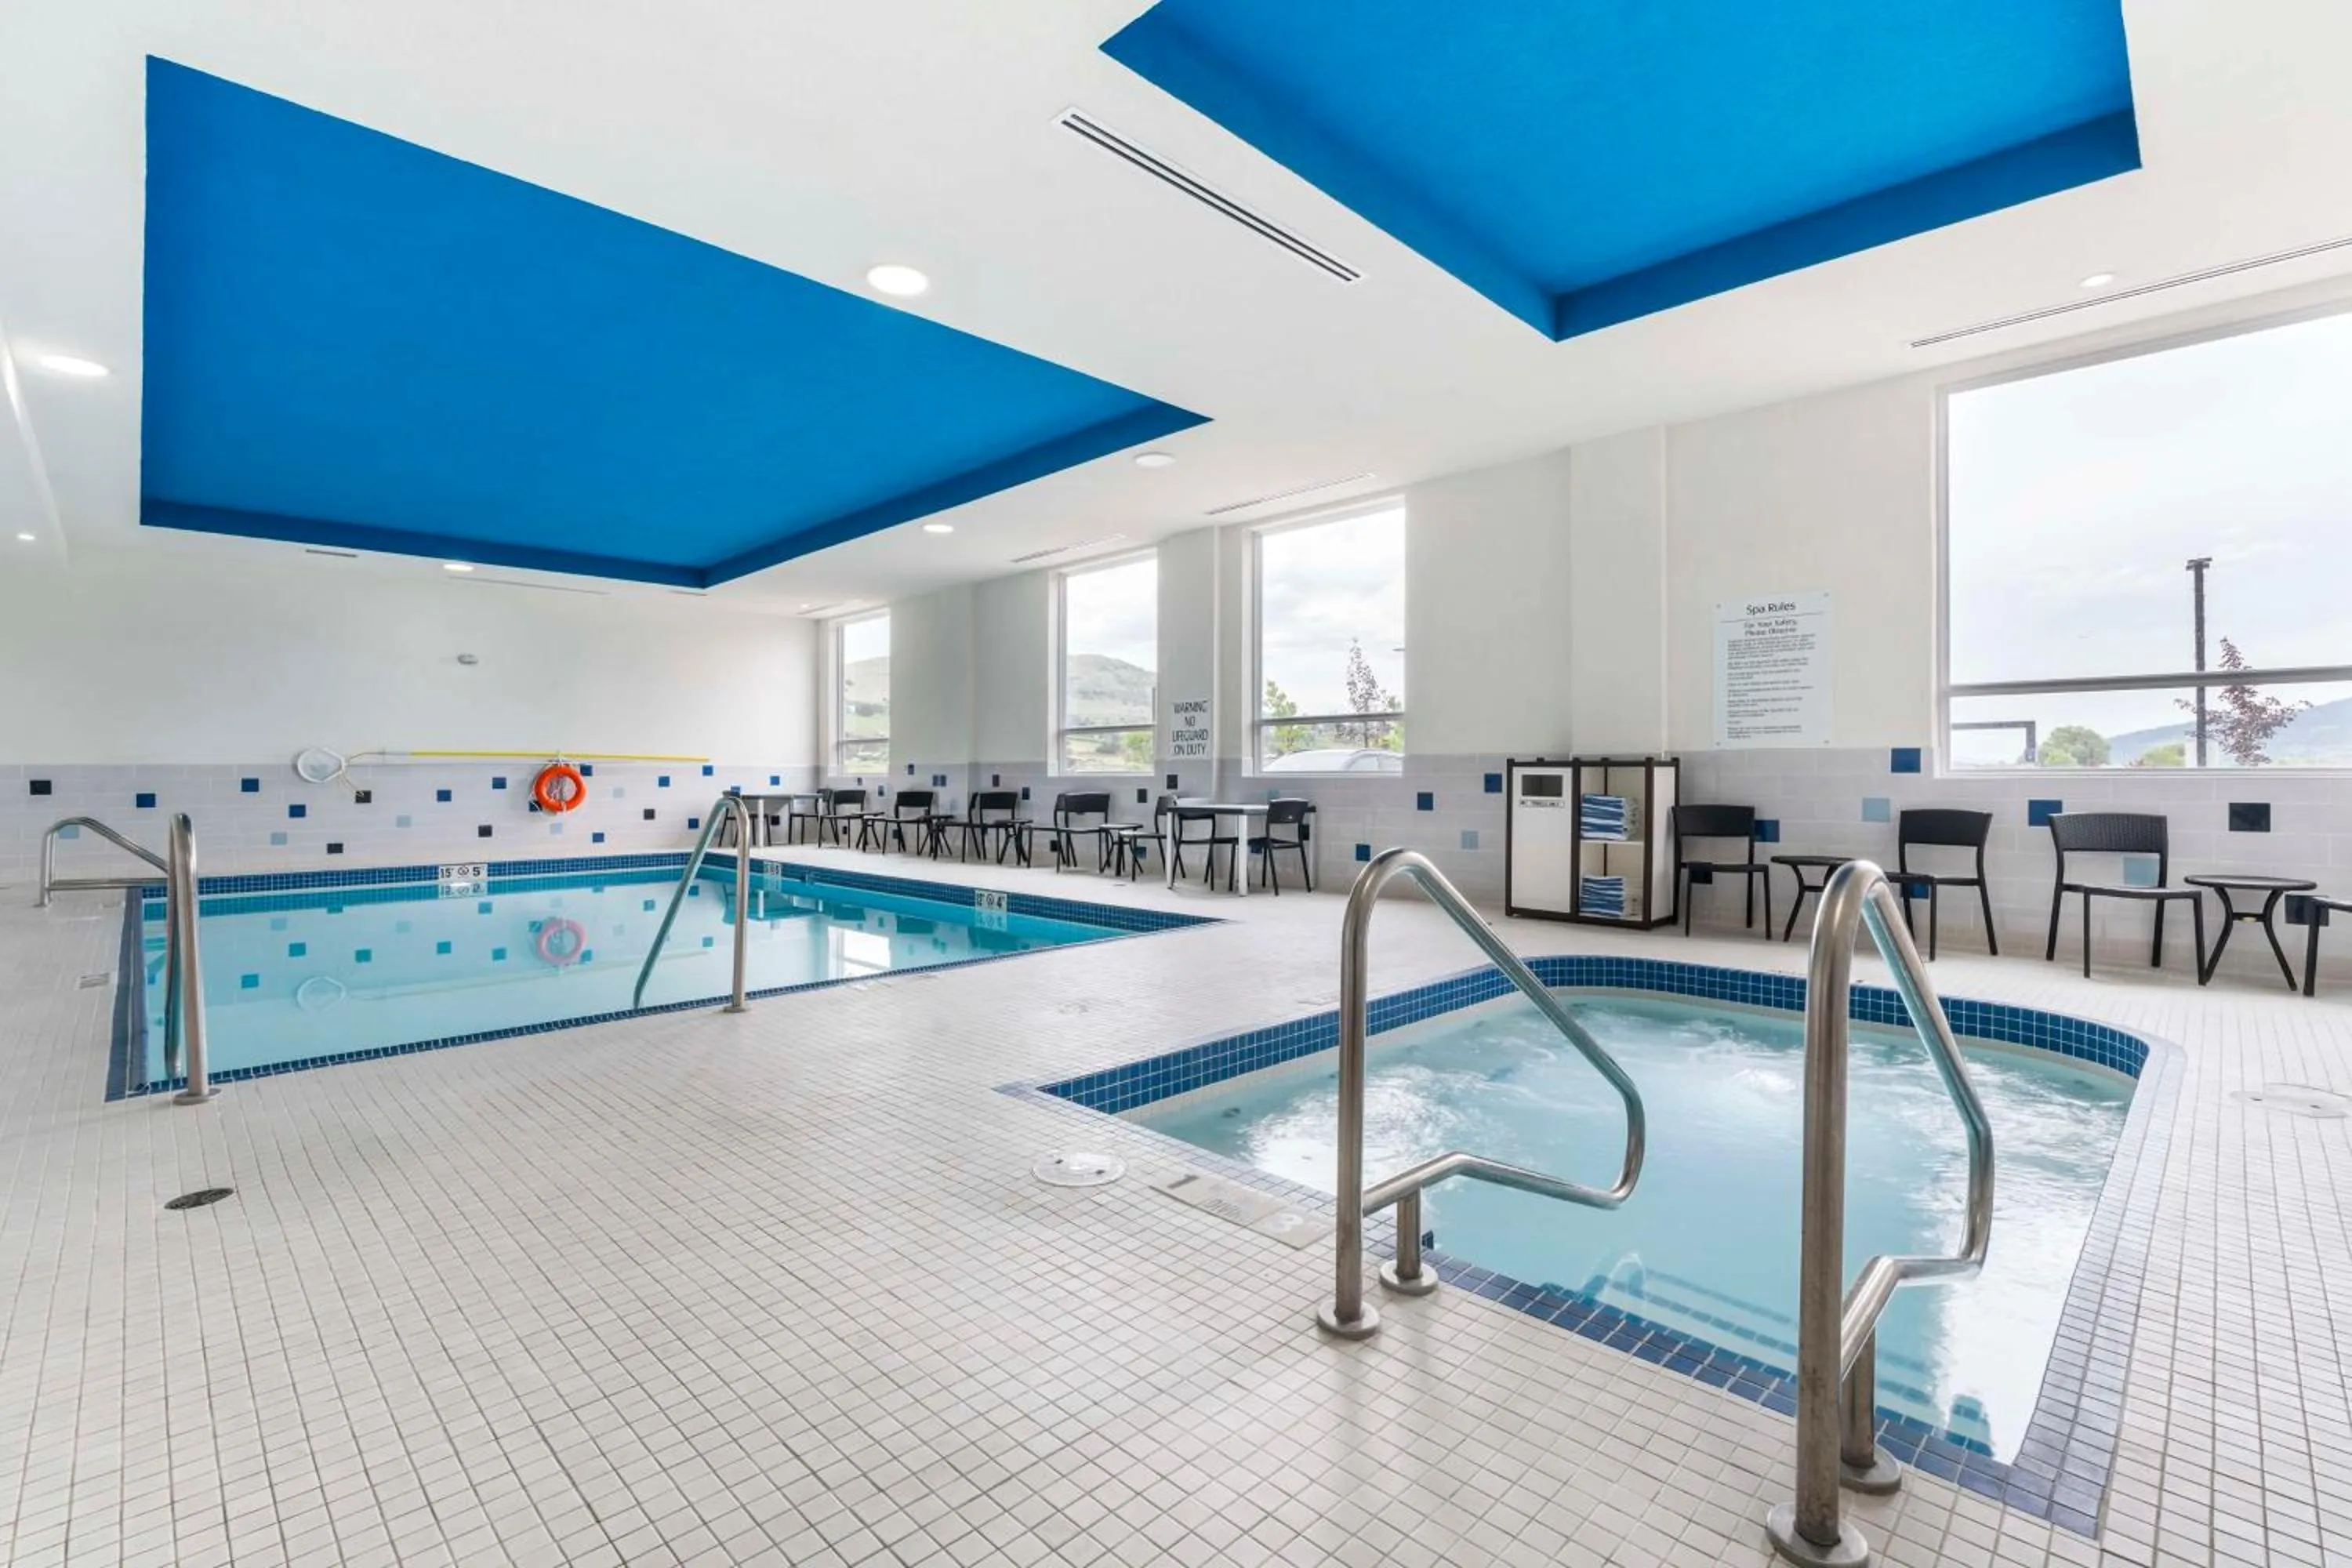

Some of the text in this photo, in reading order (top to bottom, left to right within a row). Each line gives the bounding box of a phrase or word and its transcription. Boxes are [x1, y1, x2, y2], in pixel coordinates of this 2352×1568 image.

[1746, 601, 1796, 615] Spa Rules
[1185, 715, 1196, 728] NO
[1174, 742, 1207, 756] ON DUTY
